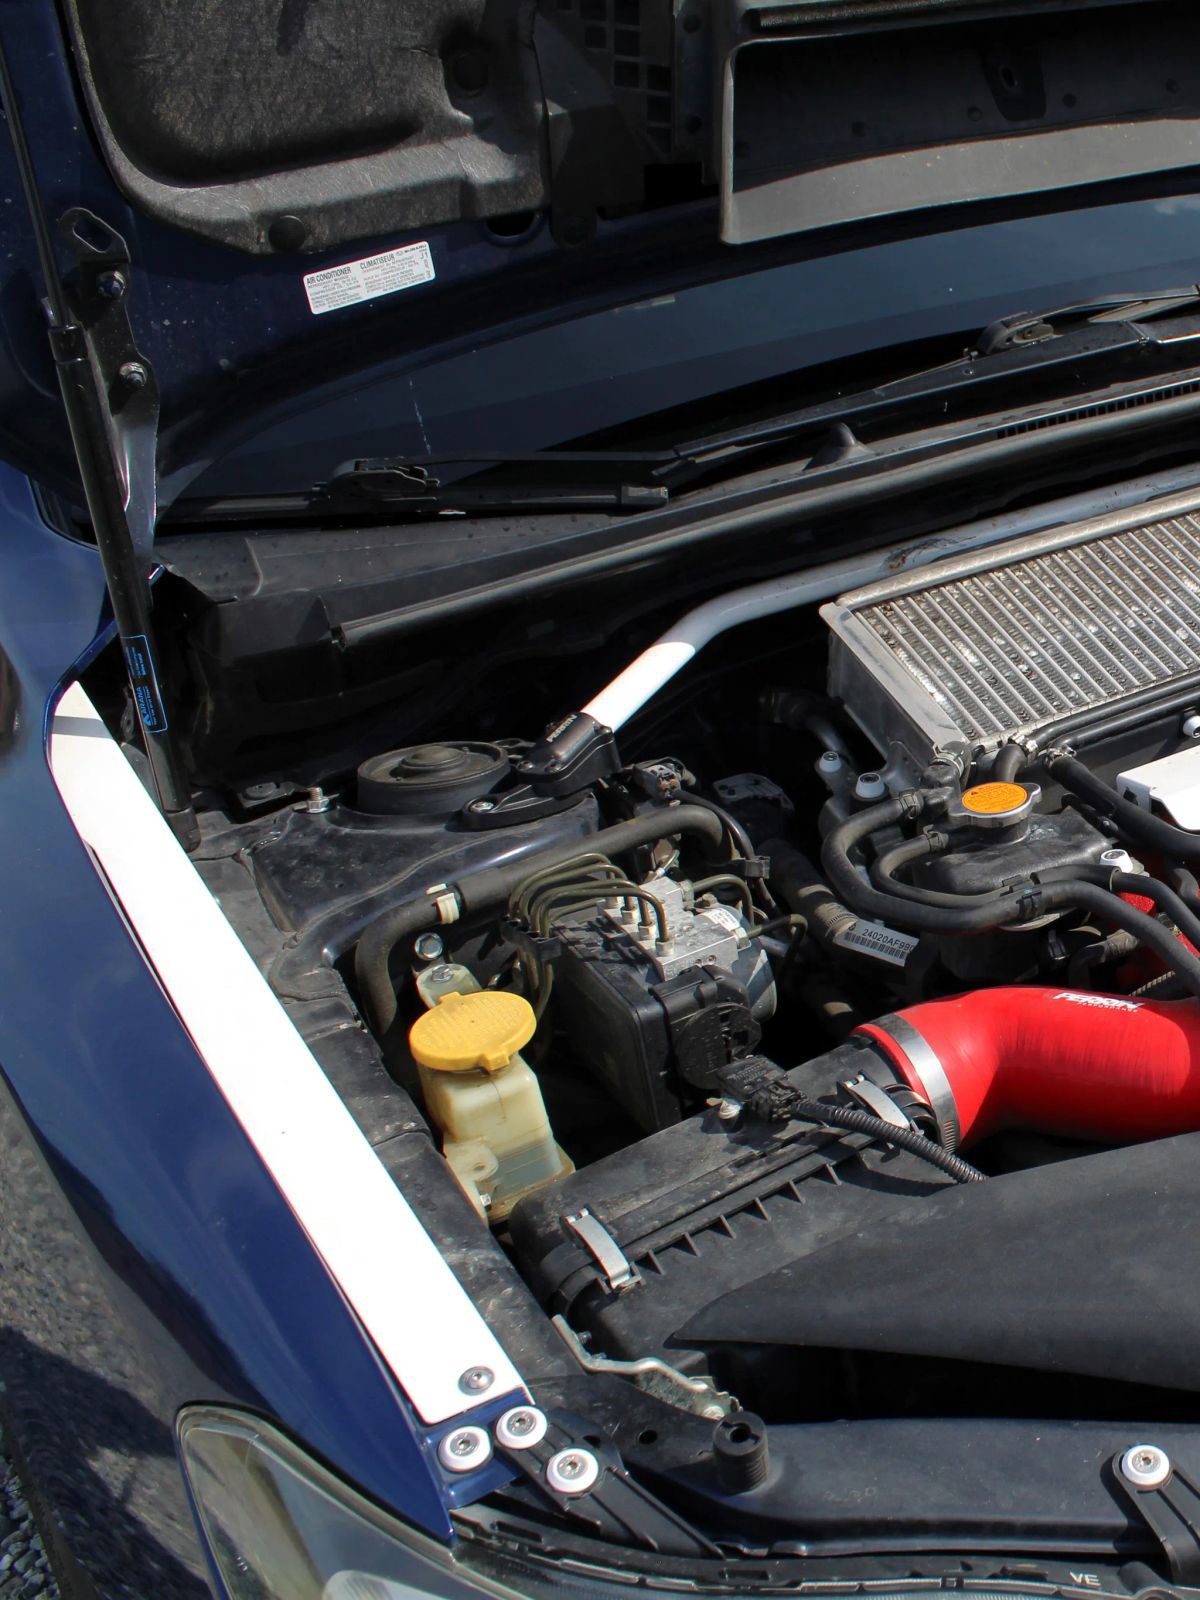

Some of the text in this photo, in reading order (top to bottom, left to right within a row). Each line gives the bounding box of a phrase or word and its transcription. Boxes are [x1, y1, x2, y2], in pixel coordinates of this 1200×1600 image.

[360, 254, 395, 270] CLIMATISEUR
[306, 267, 352, 285] AIR CONDITIONER
[1053, 992, 1145, 1010] PERRIN
[1069, 1571, 1101, 1587] VE
